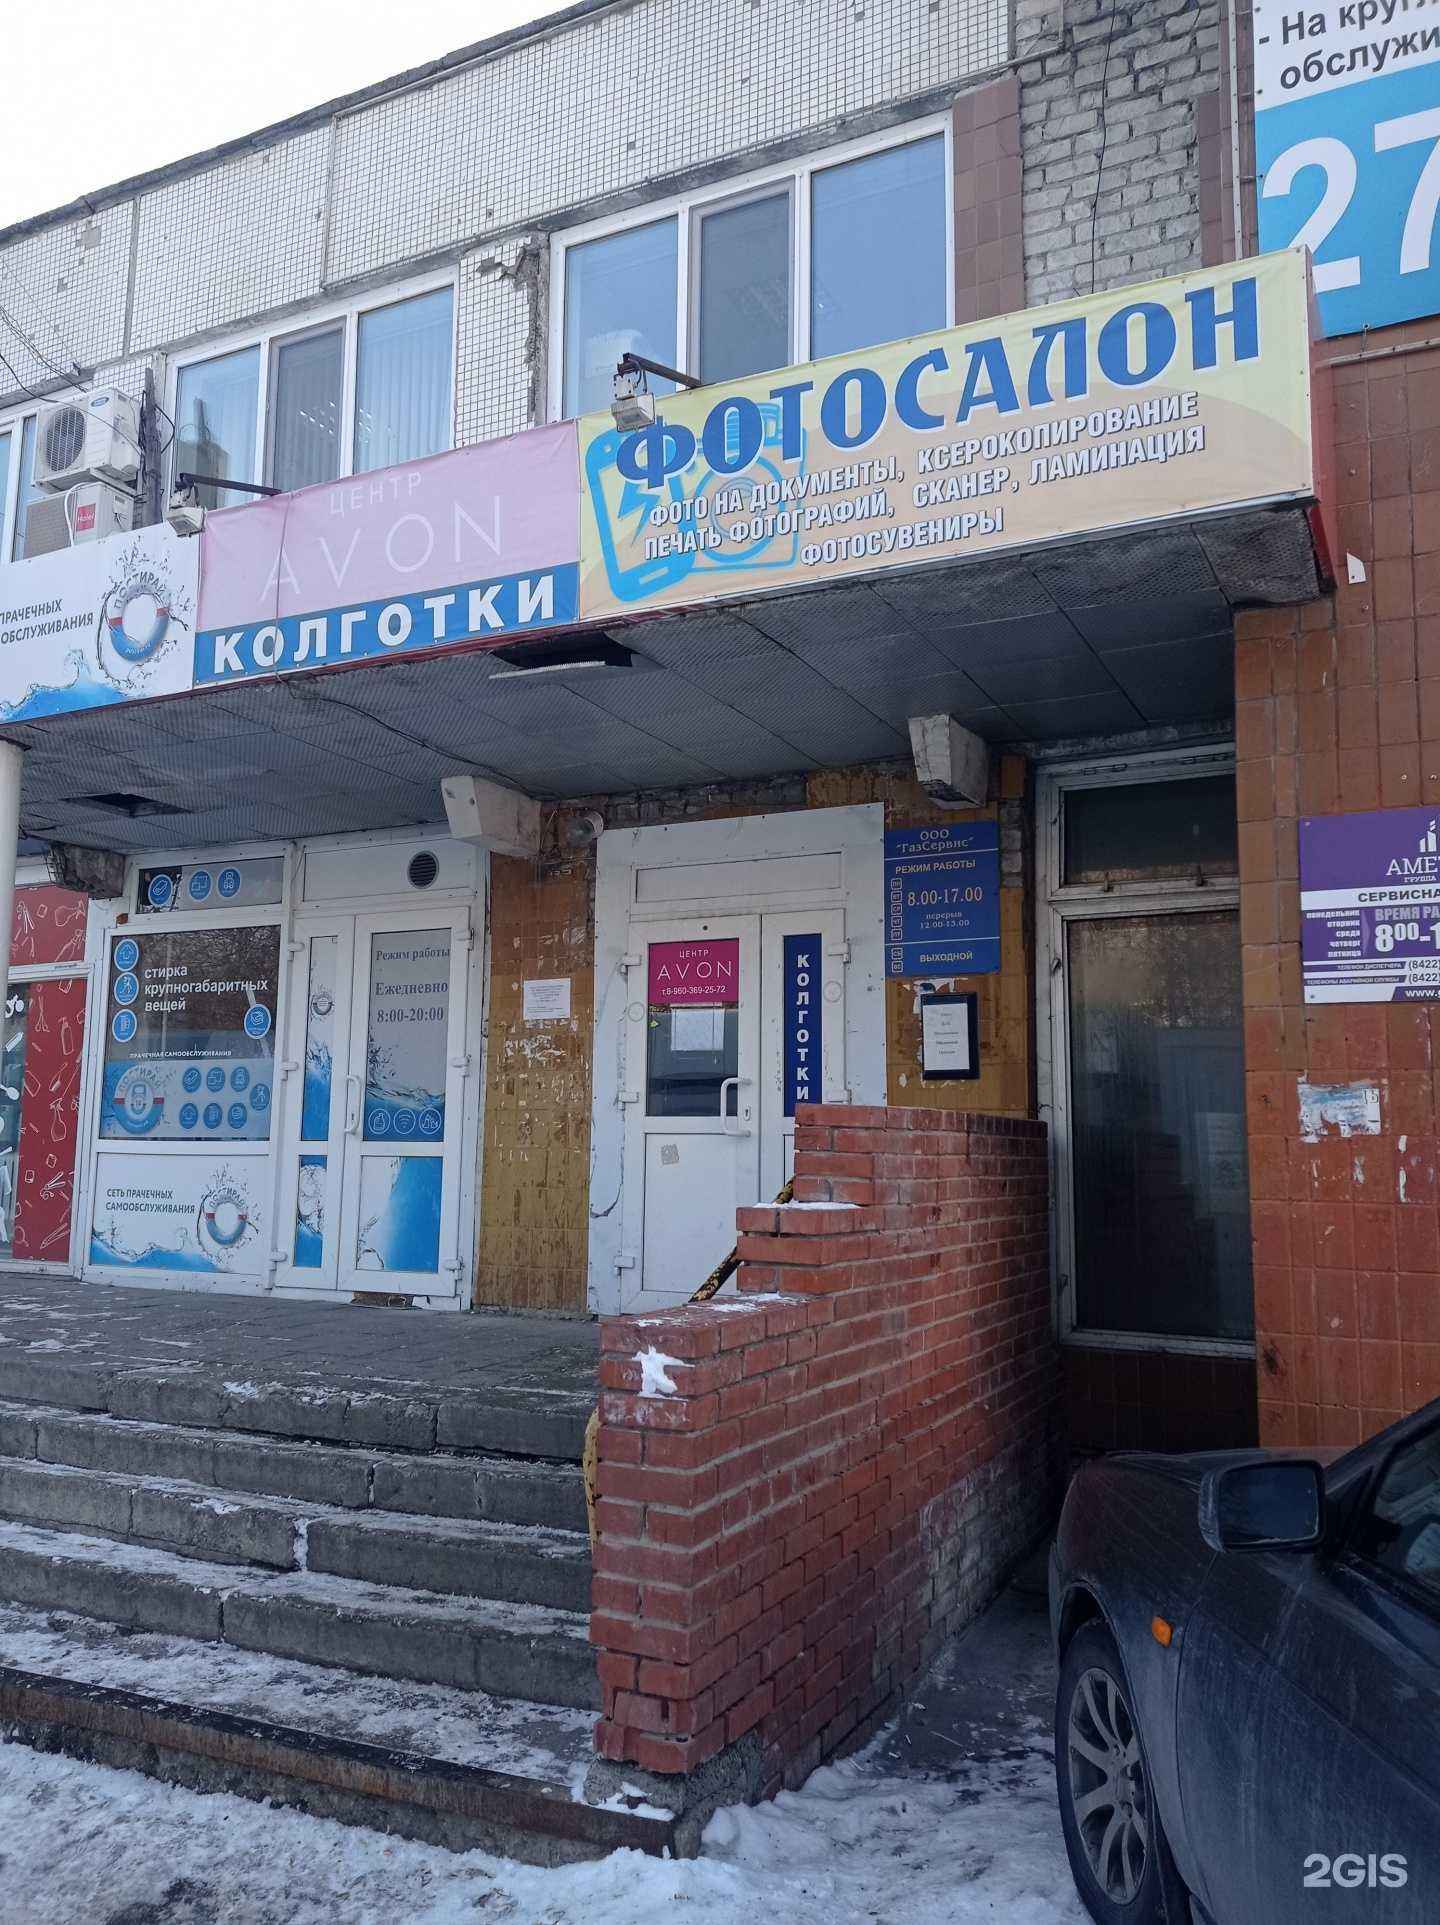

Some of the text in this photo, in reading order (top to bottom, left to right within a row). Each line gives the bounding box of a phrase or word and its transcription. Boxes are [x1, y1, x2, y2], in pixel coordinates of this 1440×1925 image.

[1282, 11, 1327, 45] На
[616, 277, 1259, 489] ФОТОСАЛОН
[649, 391, 1200, 526] ФОТО НА ДОКУМЕНТЫ, КСЕРОКОПИРОВАНИЕ
[329, 472, 423, 517] ЦЕНТР
[644, 424, 1206, 561] ПЕЧАТЬ ФОТОГРАФИЙ, СКАНЕР, ЛАМИНАЦИЯ
[800, 508, 1004, 567] ФОТОСУВЕНИРЫ
[258, 495, 502, 603] AVON
[213, 575, 556, 675] КОЛГОТКИ
[920, 829, 949, 841] ООО
[895, 859, 976, 875] РЕЖИМ РАБОТЫ
[907, 886, 983, 906] 8.00-17.00
[1375, 906, 1420, 921] ВРЕМЯ
[376, 947, 450, 961] Режим работы
[680, 949, 708, 959] ЦЕНТР
[920, 951, 973, 962] ВЫХОДНОЙ
[144, 965, 188, 979] стирка
[657, 960, 732, 980] AVON
[144, 978, 268, 998] крупногабаритных
[375, 982, 448, 996] Ежедневно
[144, 997, 186, 1013] вещей
[377, 1007, 444, 1023] 8:00-20:00
[796, 954, 810, 1100] КОЛГОТКИ
[107, 1188, 173, 1200] СЕТЬ ПРАЧЕЧНЫХ
[105, 1202, 195, 1214] САМООБСЛУЖИВАНИЯ
